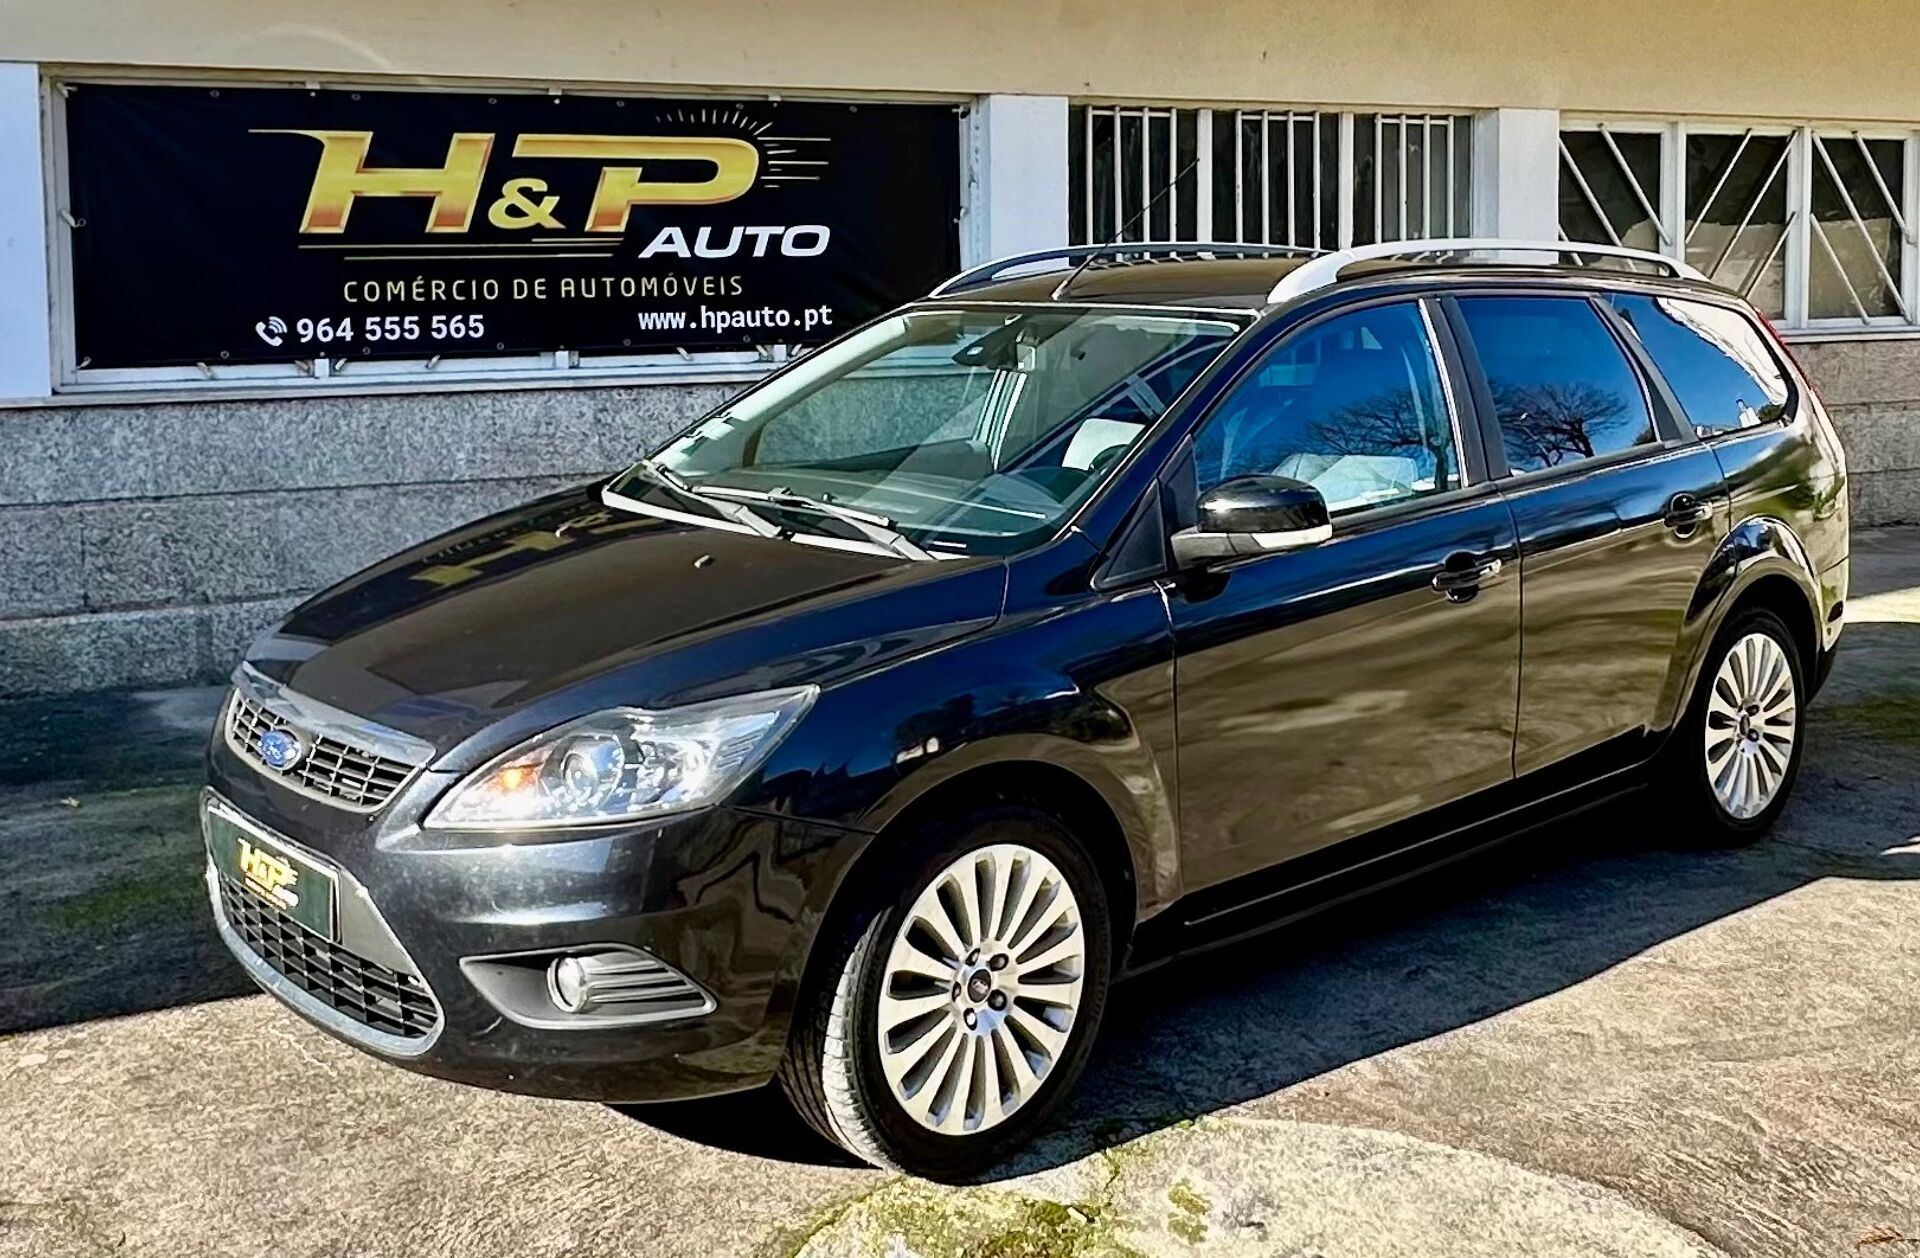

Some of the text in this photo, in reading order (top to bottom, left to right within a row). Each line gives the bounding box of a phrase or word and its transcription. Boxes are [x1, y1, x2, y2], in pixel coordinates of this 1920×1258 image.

[248, 129, 760, 233] H&P
[637, 225, 832, 259] AUTO
[343, 274, 745, 303] COMÉRCIO DE AUTOMÓVEIS
[296, 314, 486, 343] 964 555 565
[637, 304, 833, 334] www.hpauto.pt
